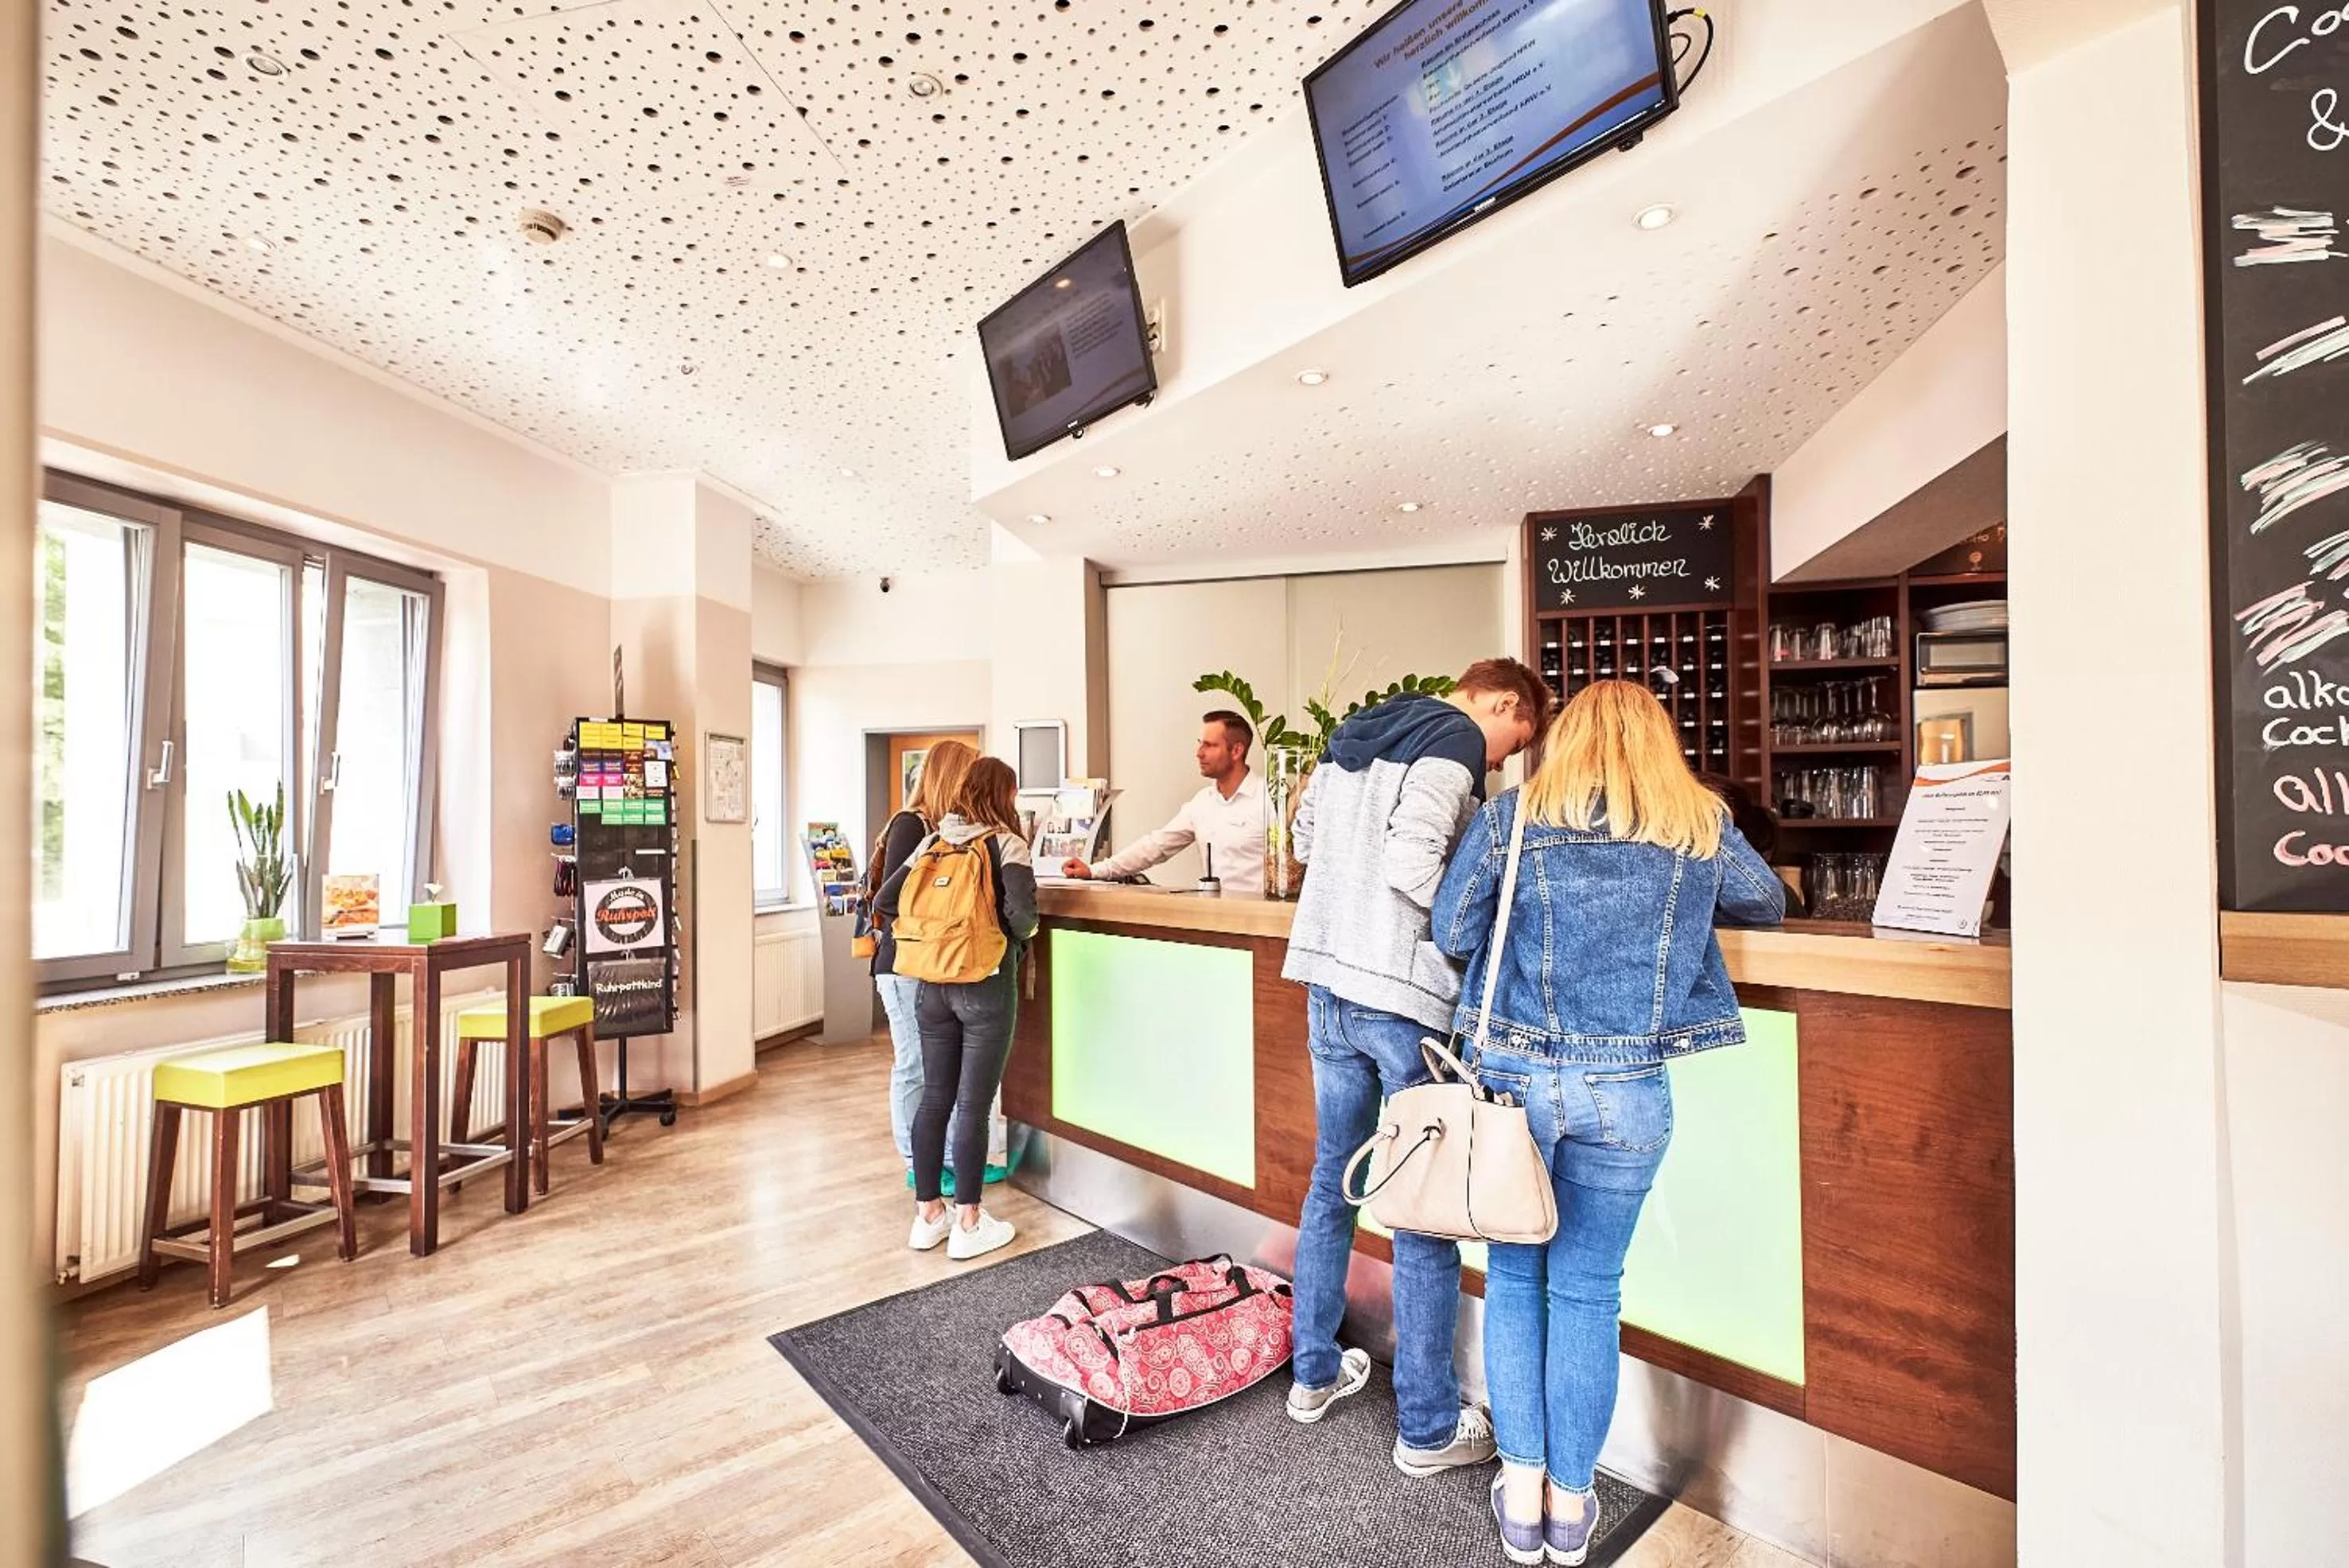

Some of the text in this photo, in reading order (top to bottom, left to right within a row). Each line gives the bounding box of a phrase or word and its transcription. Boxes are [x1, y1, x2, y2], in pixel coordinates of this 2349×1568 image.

[1404, 28, 1444, 60] herzlich
[1373, 51, 1391, 68] Wir
[2307, 88, 2349, 150] &
[1569, 519, 1672, 551] Herzlich
[1547, 555, 1691, 583] Willkommen
[609, 887, 635, 901] Made
[596, 979, 664, 993] Ruhrpottkind
